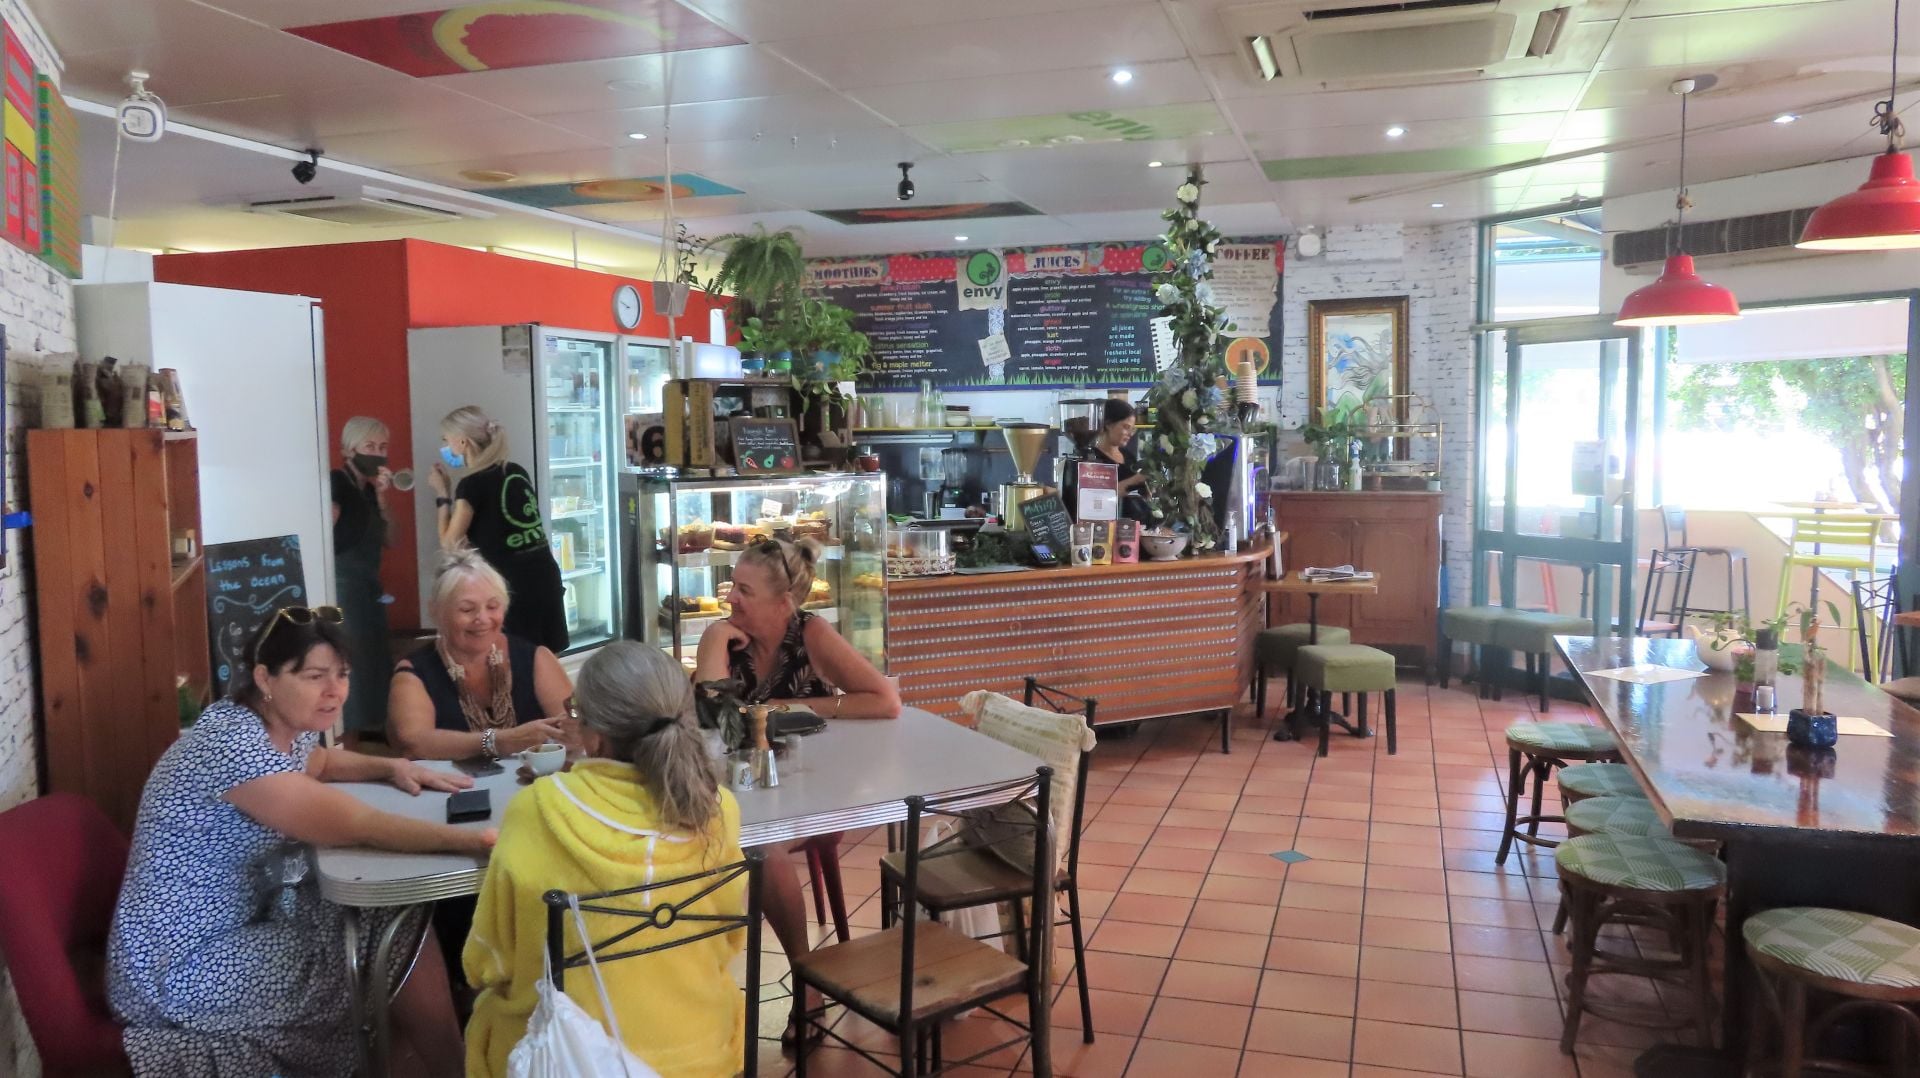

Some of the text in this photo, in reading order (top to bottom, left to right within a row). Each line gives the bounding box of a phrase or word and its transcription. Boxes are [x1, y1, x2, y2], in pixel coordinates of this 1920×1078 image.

[1215, 248, 1270, 260] COFFEE
[1034, 256, 1080, 269] JUICES
[964, 286, 1002, 300] envy
